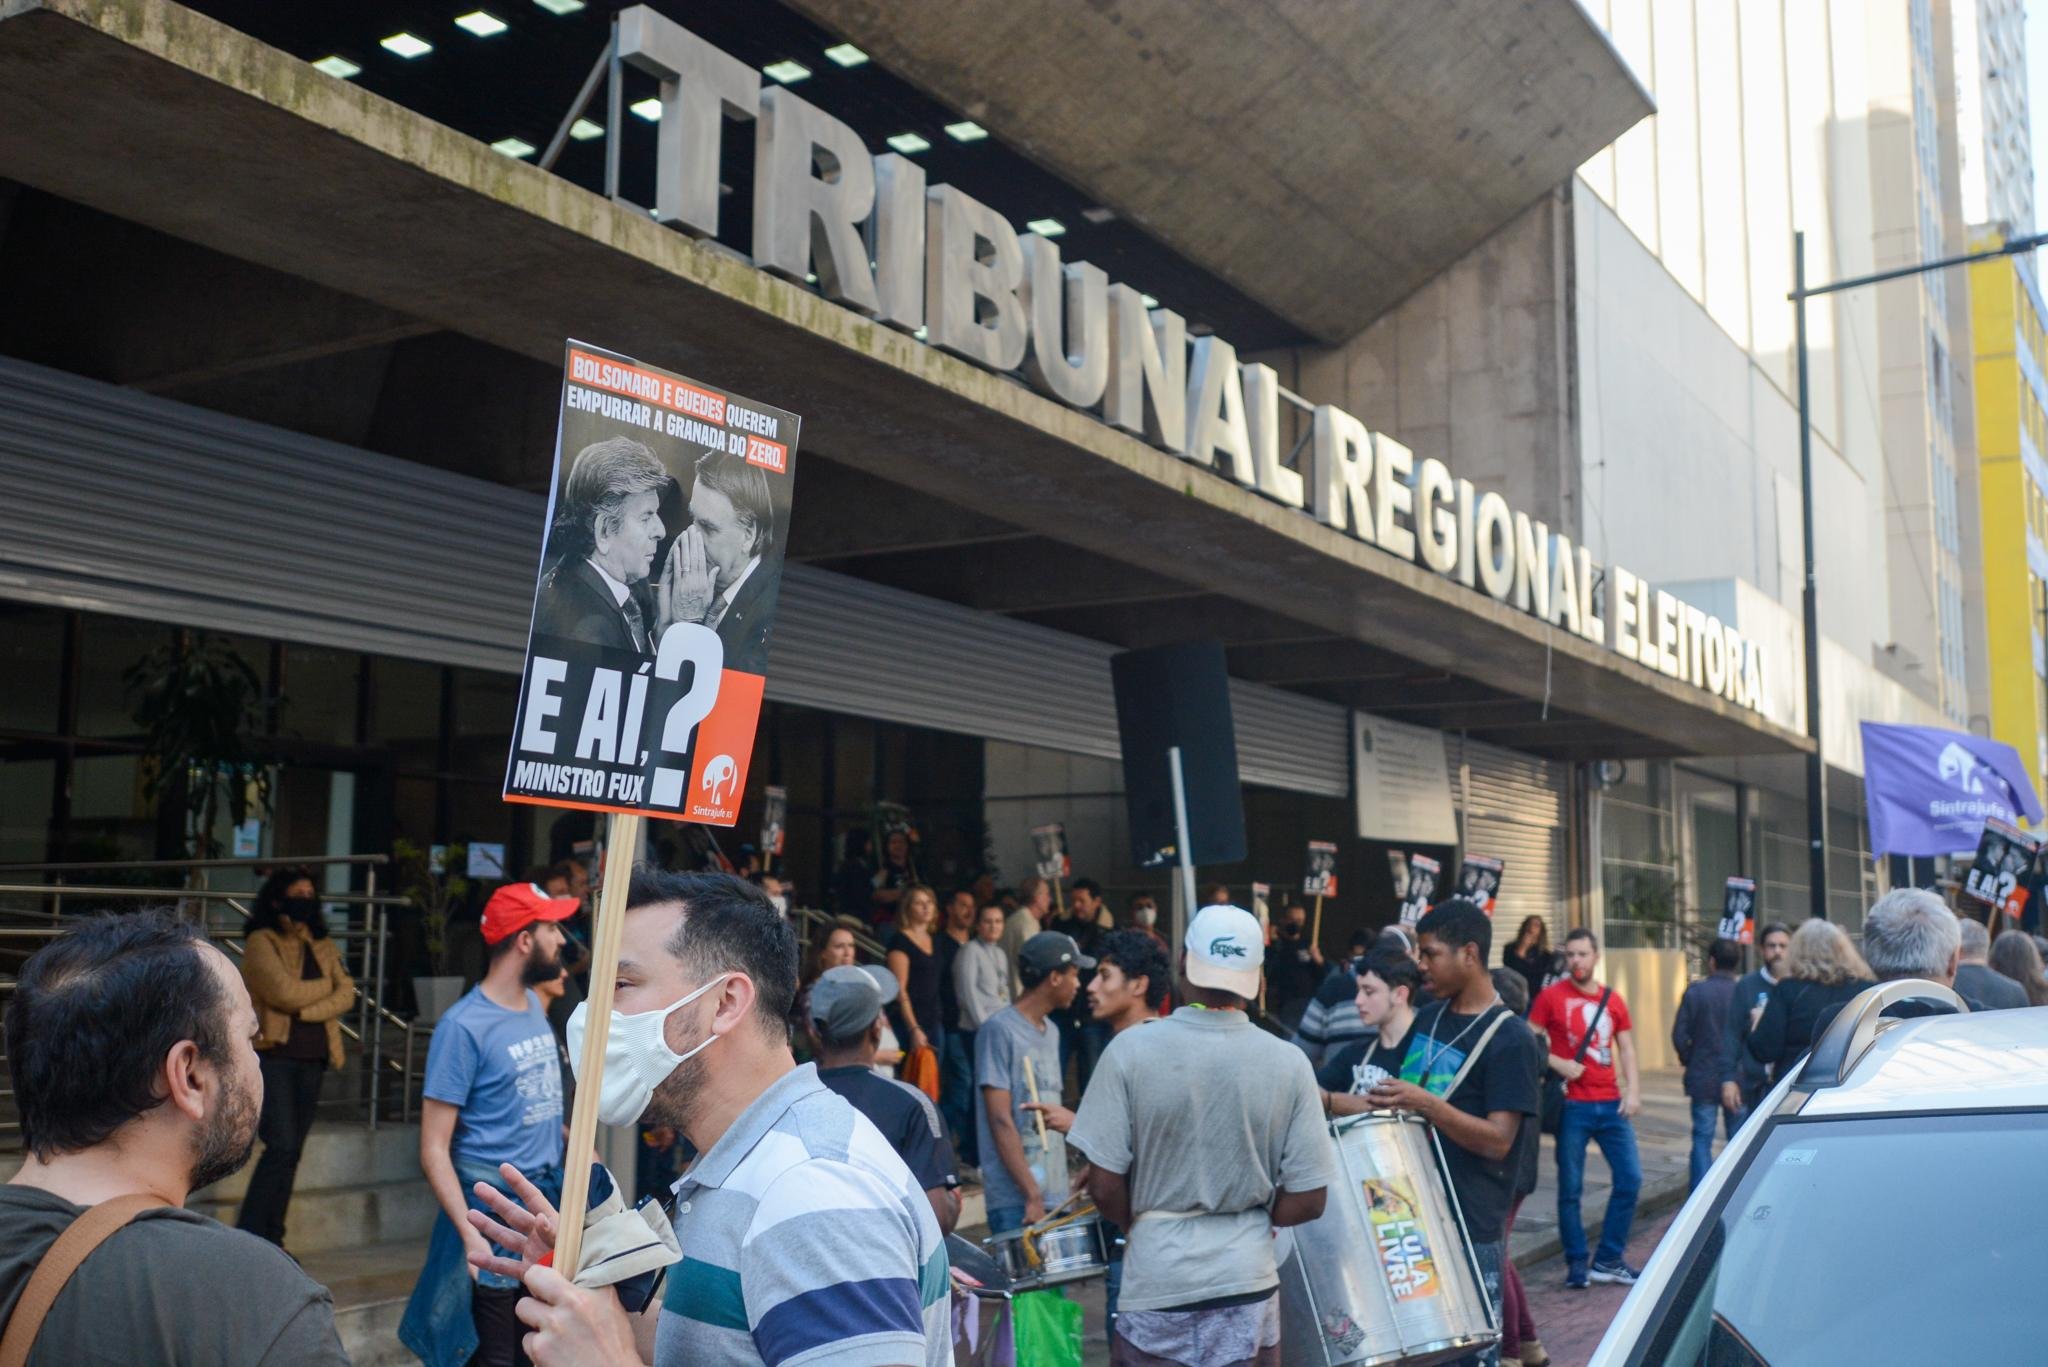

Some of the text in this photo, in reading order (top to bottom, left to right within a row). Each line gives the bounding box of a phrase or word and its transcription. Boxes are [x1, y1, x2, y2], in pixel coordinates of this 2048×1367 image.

[573, 356, 778, 438] BOLSONARO E GUEDES QUEREM
[618, 3, 1776, 722] TRIBUNAL REGIONAL ELEITORAL
[567, 385, 783, 469] EMPURRAR A GRANADA DO ZERO.
[520, 656, 568, 754] E
[512, 760, 645, 802] MINISTRO FUX
[693, 805, 725, 819] Sintrajufe
[1376, 1222, 1412, 1298] LIVRE
[1397, 1221, 1429, 1287] LULA
